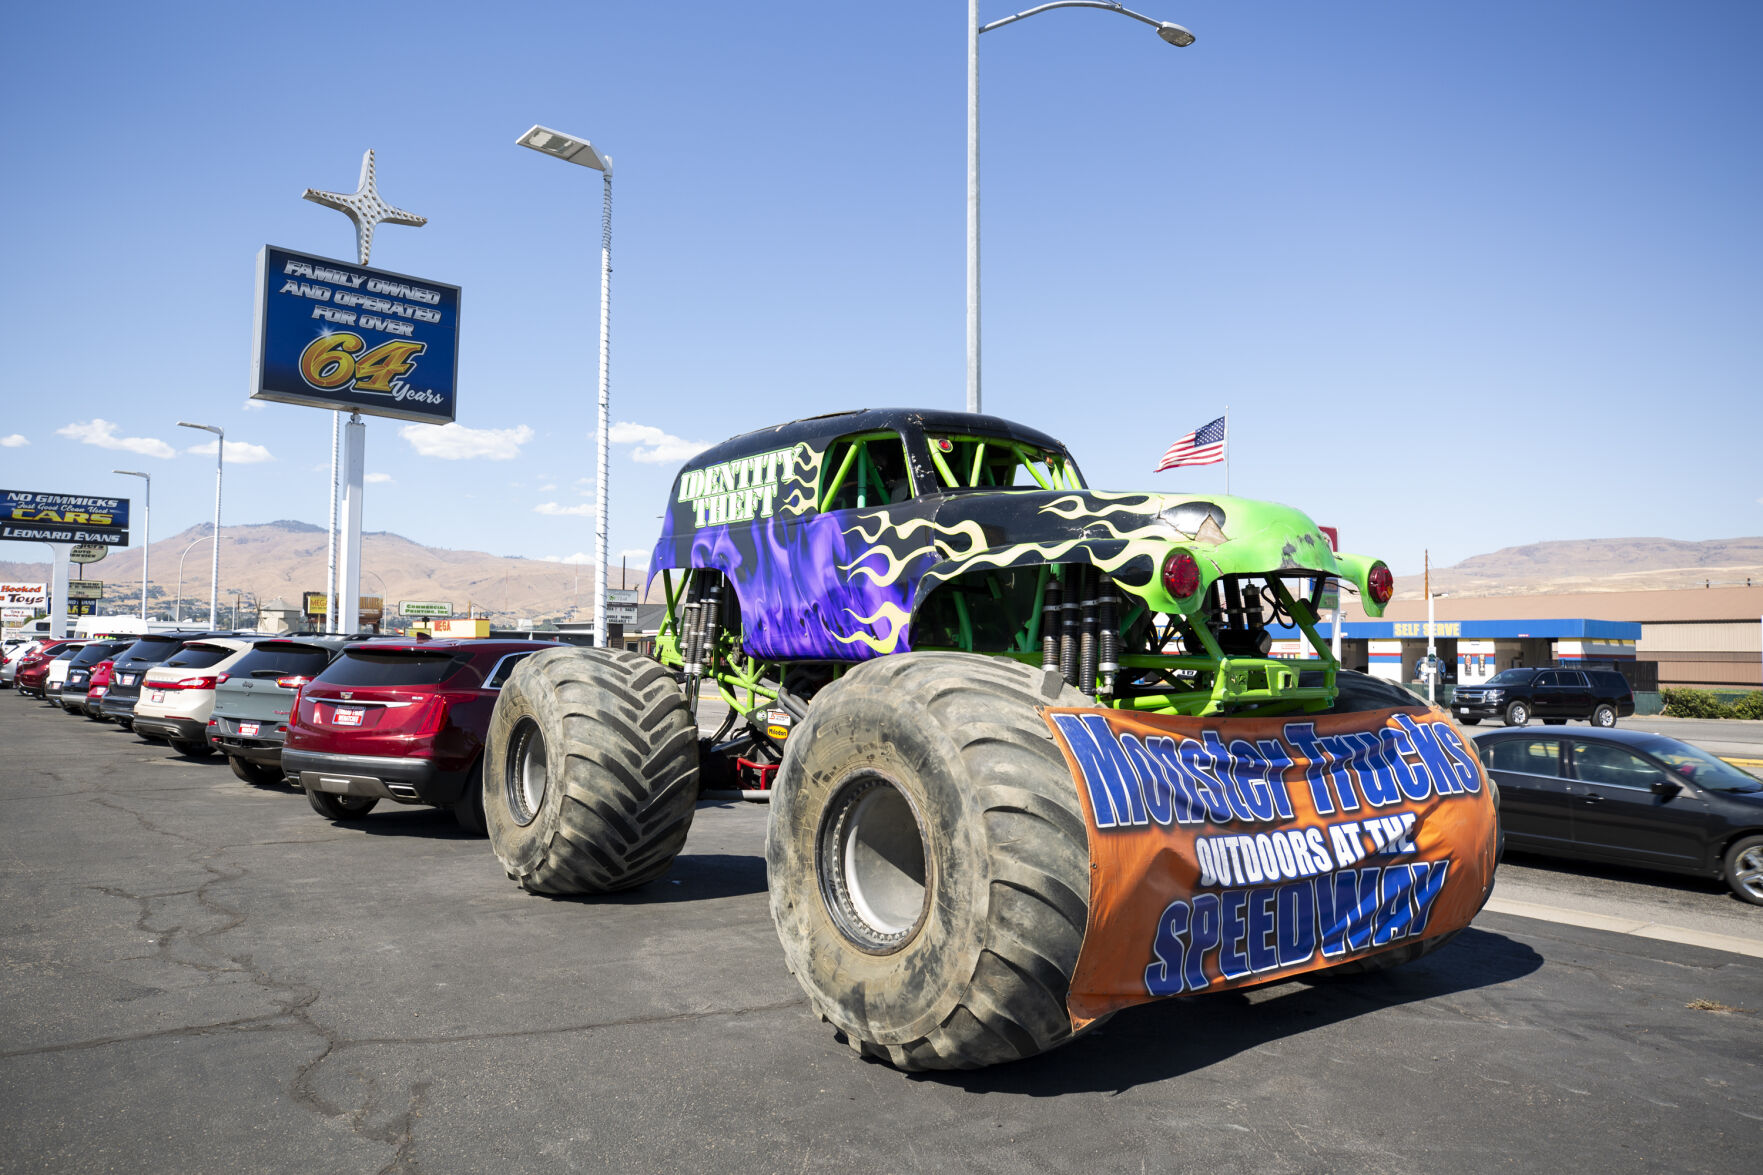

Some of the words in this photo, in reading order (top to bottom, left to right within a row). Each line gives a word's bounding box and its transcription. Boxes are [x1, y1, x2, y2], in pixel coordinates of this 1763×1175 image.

[283, 259, 367, 288] FAMILY
[367, 278, 441, 305] OWNED
[280, 279, 331, 301] AND
[333, 291, 441, 324] OPERATED
[312, 305, 357, 326] FOR
[359, 314, 414, 337] OVER
[298, 331, 427, 396] 64
[390, 380, 444, 404] Years
[678, 446, 804, 503] IDENTITY
[7, 492, 33, 502] NO
[35, 495, 119, 508] GIMMICKS
[17, 501, 36, 509] Just
[37, 503, 59, 511] Good
[60, 504, 85, 513] Clean
[87, 506, 109, 514] Used
[692, 482, 778, 528] THEFT
[11, 508, 114, 525] CARS
[2, 527, 72, 540] LEONARD
[73, 531, 121, 543] EVANS
[1, 585, 42, 593] Hooked
[8, 593, 45, 604] Toys
[1394, 623, 1420, 637] SELF
[768, 728, 787, 737] Milodon
[1050, 712, 1294, 827] Monster
[1284, 713, 1481, 815] Trucks
[1195, 827, 1334, 887] OUTDOORS
[1332, 819, 1370, 868] AT
[1364, 813, 1417, 855] THE
[1144, 860, 1450, 997] SPEEDWAY
